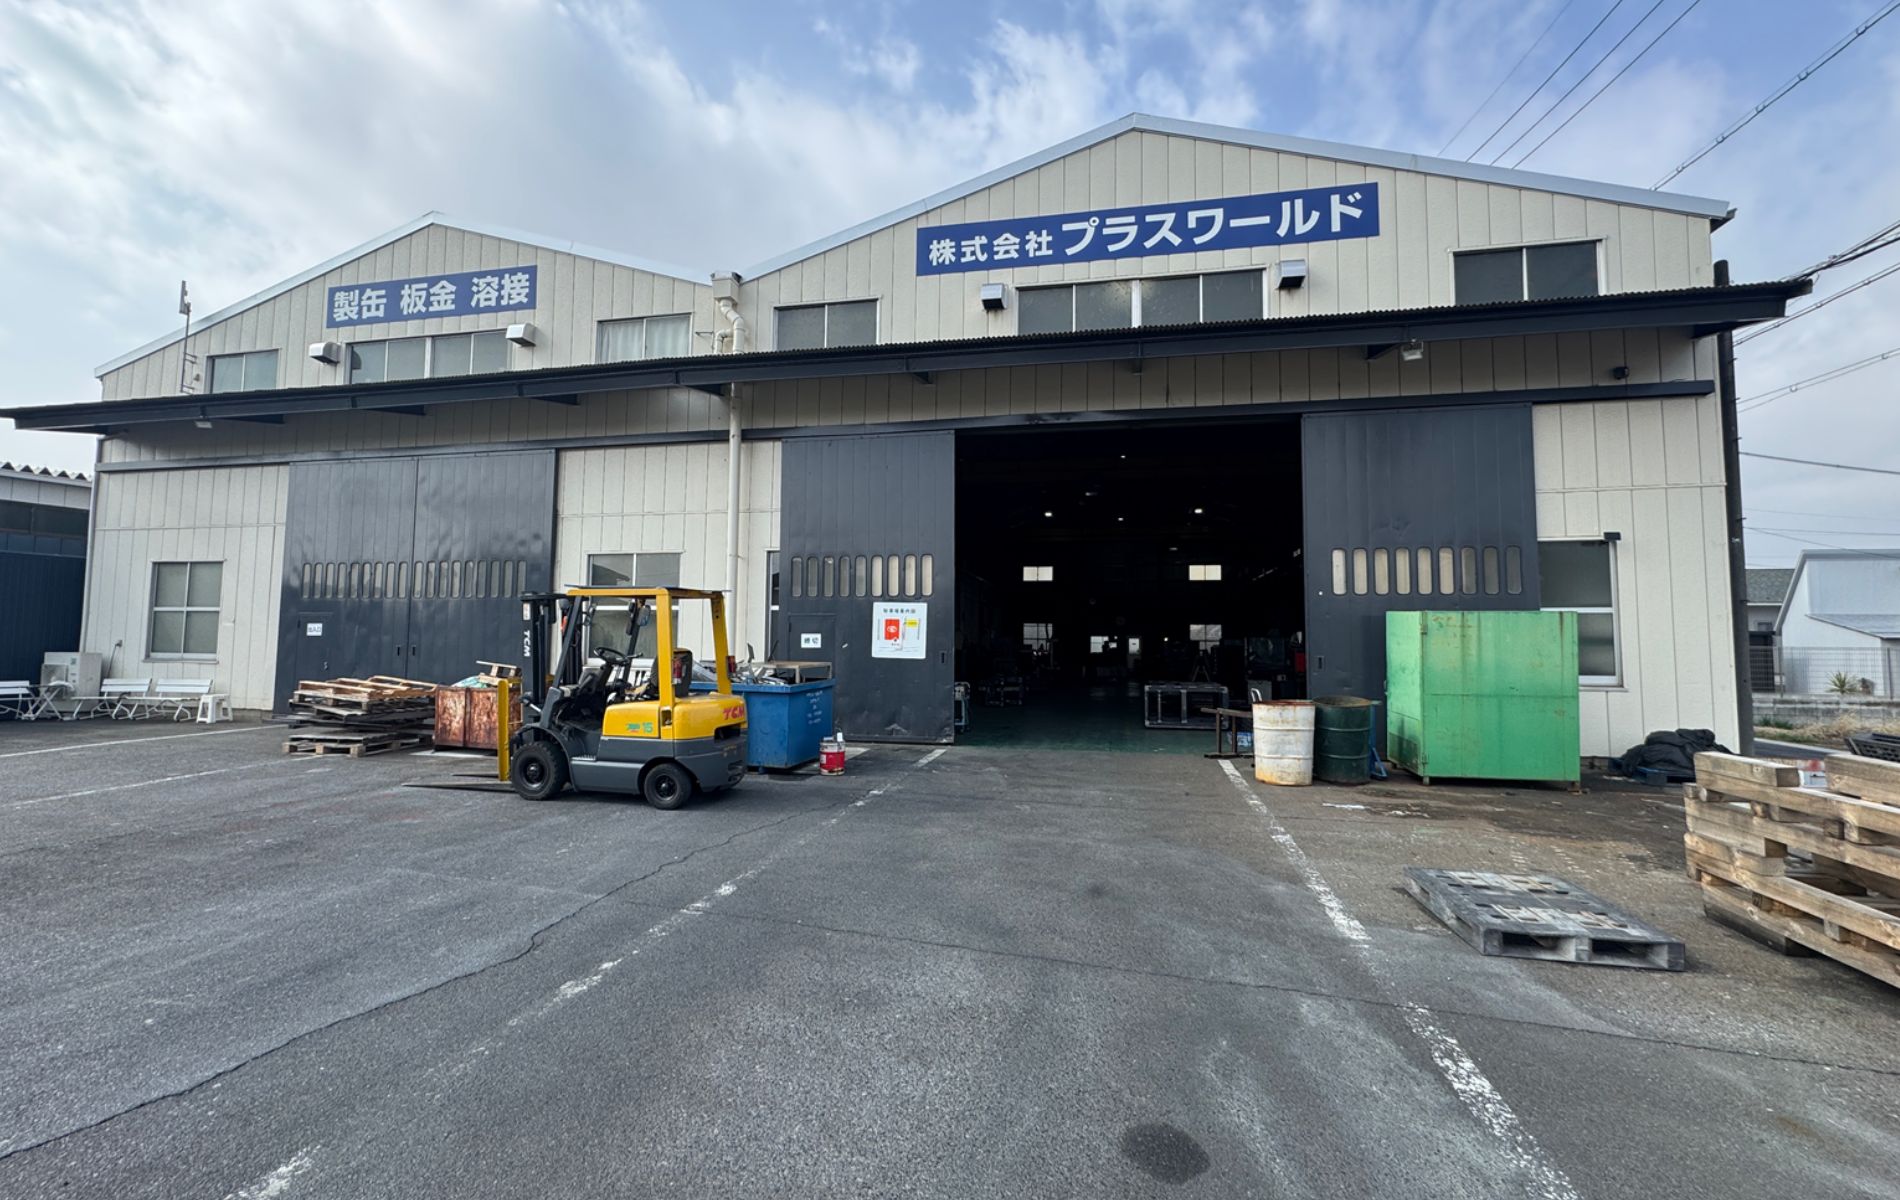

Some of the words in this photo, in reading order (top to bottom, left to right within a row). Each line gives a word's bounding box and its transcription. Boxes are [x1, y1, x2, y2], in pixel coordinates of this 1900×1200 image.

[929, 191, 1363, 266] 株式会社プラスワールド
[333, 288, 387, 322] 製缶
[400, 280, 456, 315] 板金
[470, 272, 530, 308] 溶接
[523, 630, 531, 657] TCM
